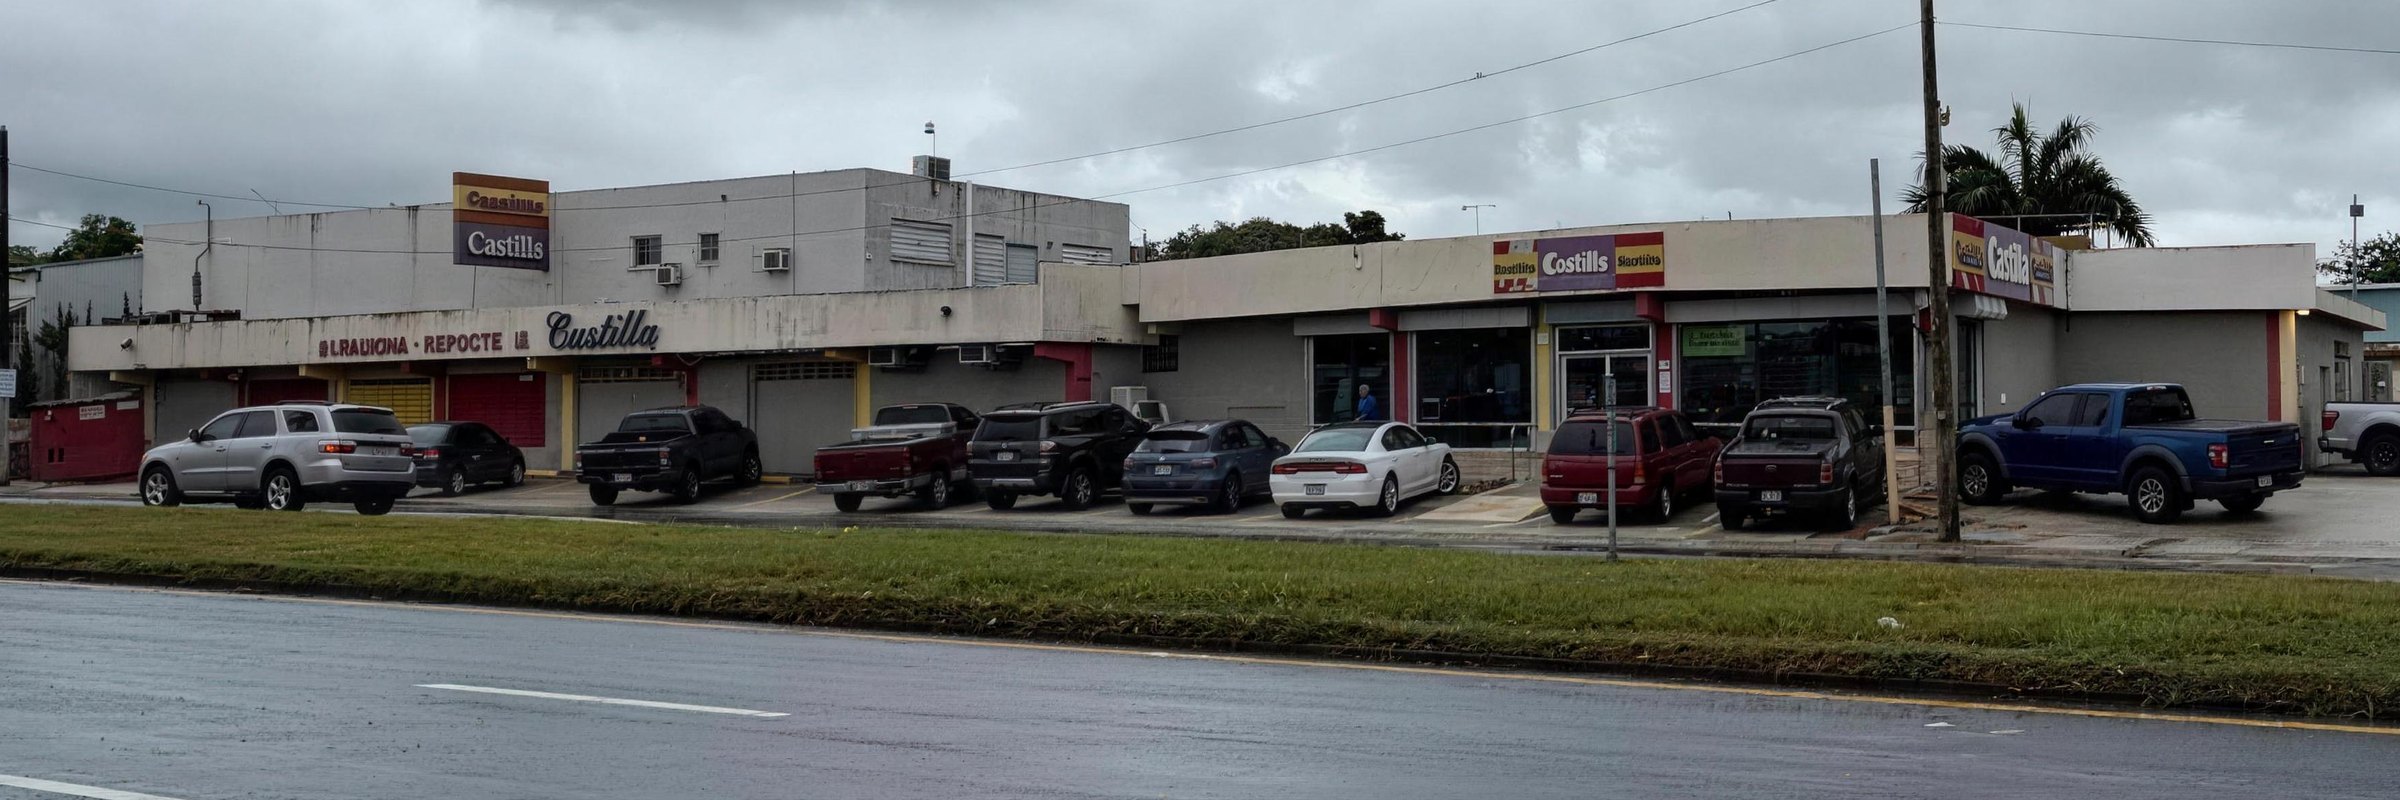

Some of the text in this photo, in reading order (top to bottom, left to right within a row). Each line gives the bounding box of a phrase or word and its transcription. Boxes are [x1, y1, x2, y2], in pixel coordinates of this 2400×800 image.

[468, 231, 544, 259] Castills
[1543, 250, 1609, 275] Costills
[424, 332, 503, 354] REPOCTE
